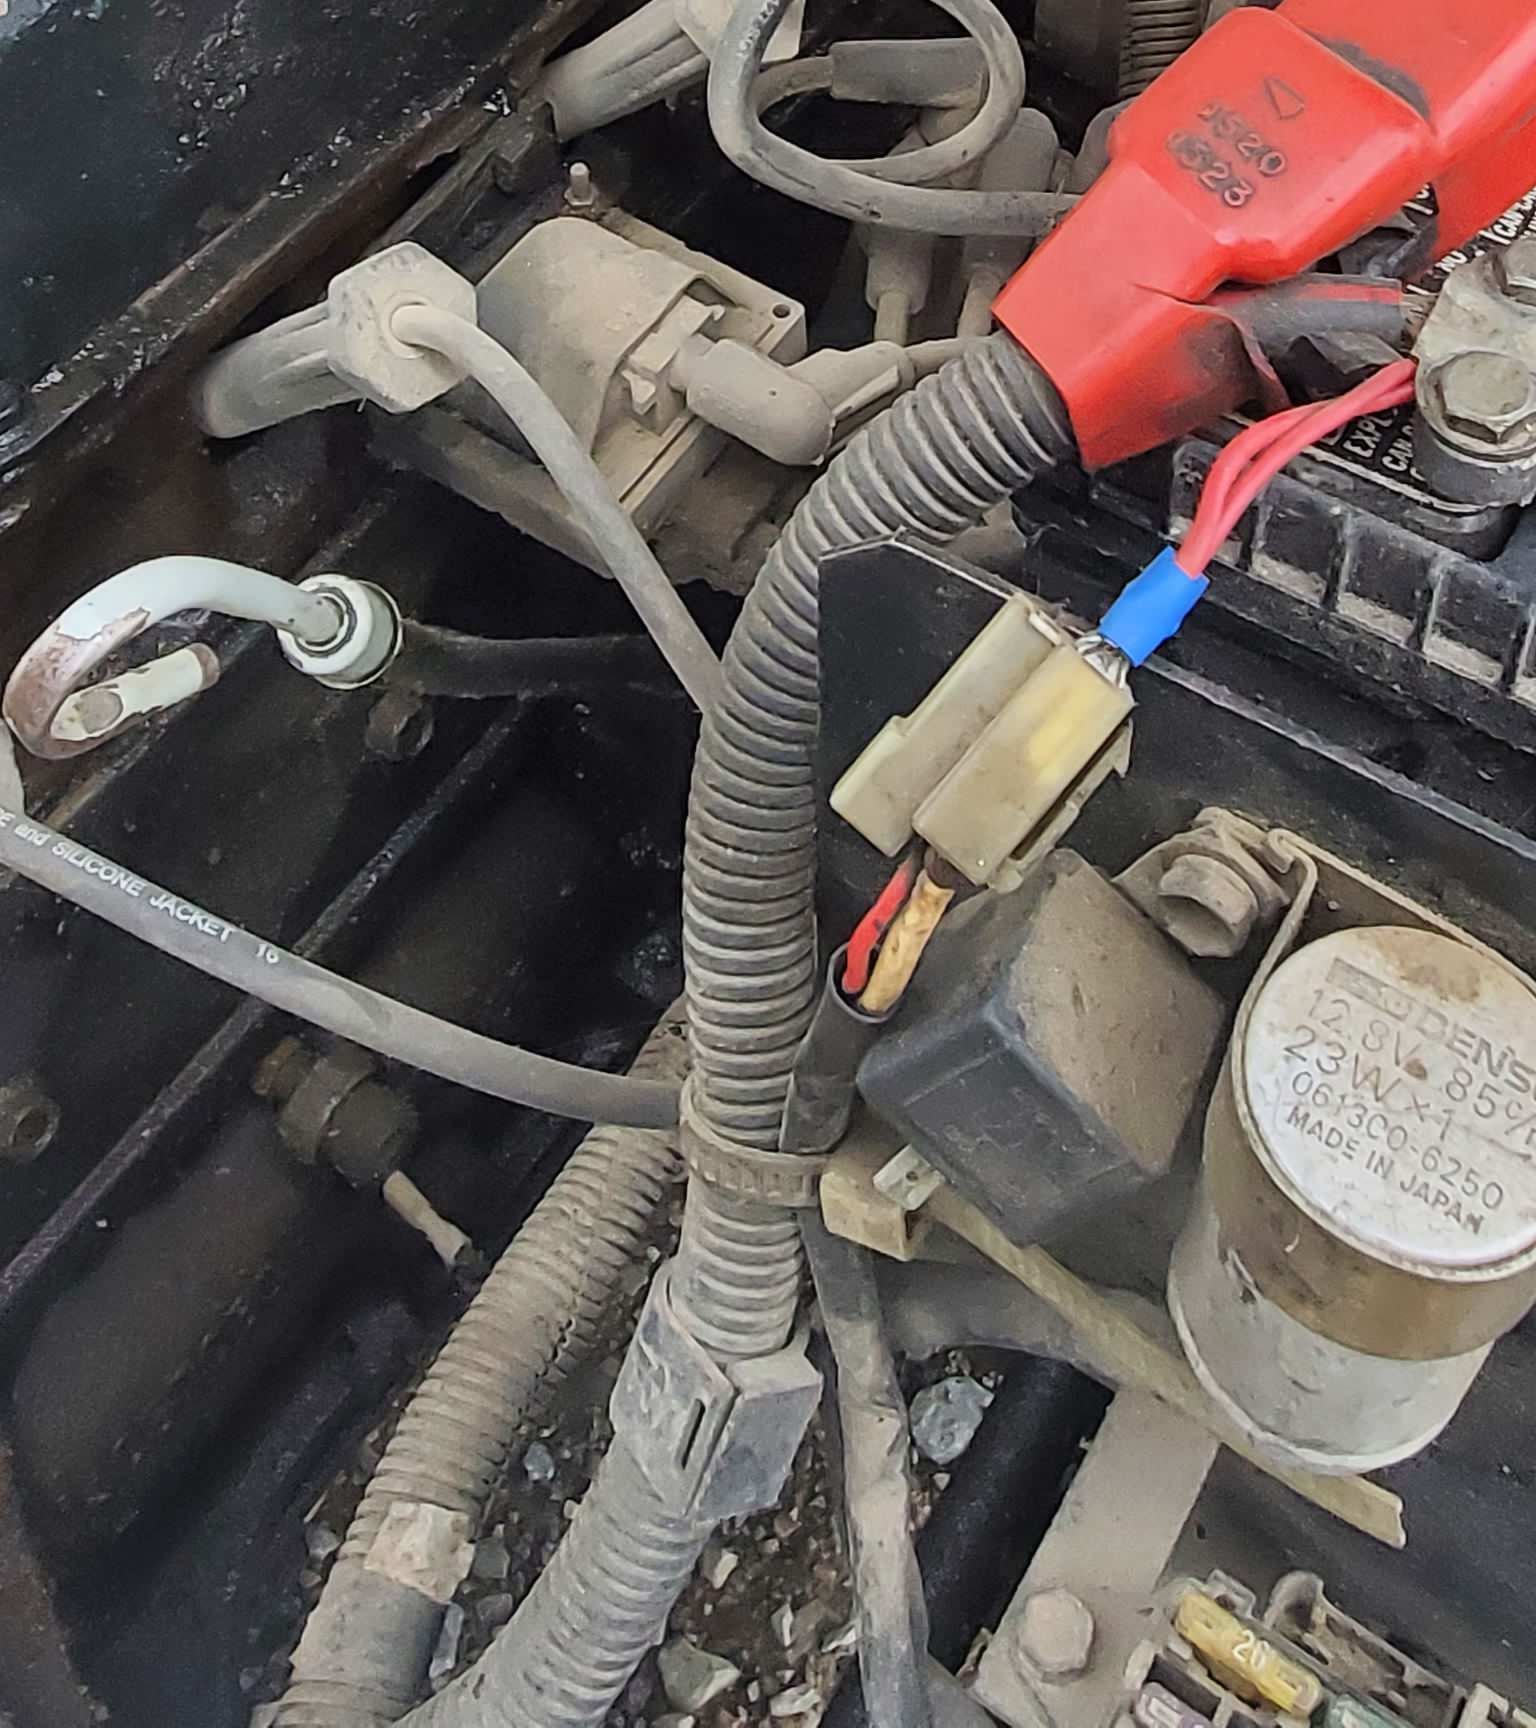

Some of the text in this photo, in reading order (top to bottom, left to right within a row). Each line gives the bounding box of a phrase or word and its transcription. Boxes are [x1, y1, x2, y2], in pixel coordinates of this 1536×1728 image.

[14, 823, 51, 846] and
[51, 838, 144, 898] SILICONE
[149, 894, 234, 942] JACKET
[1286, 1103, 1486, 1234] MADE IN JAPAN
